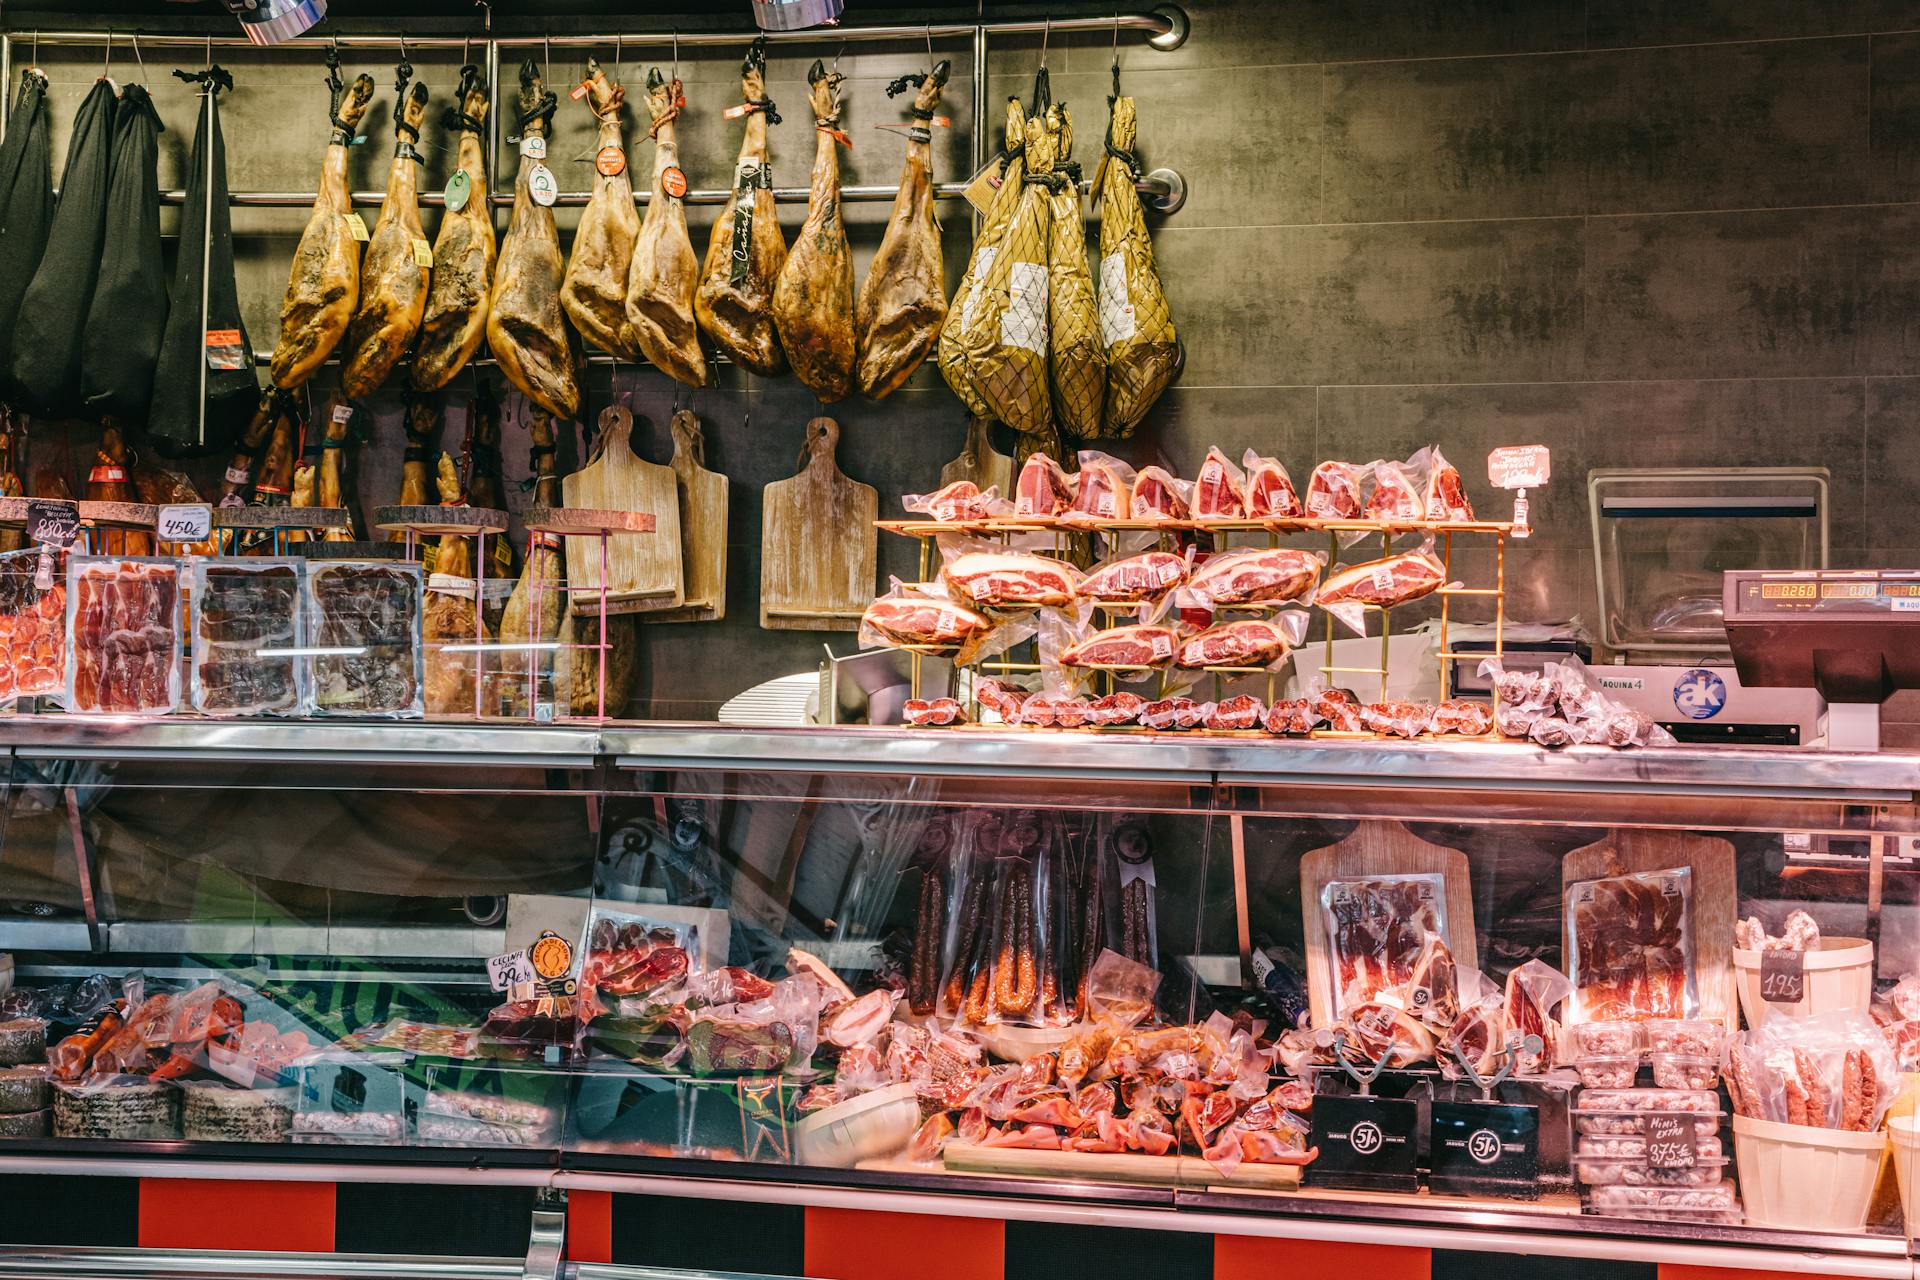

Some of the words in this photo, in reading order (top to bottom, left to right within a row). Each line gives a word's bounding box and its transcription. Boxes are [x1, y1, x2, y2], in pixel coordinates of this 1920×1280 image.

[1599, 679, 1633, 689] AQUINA
[492, 951, 523, 967] CECINA
[1656, 1128, 1684, 1139] EXTRA
